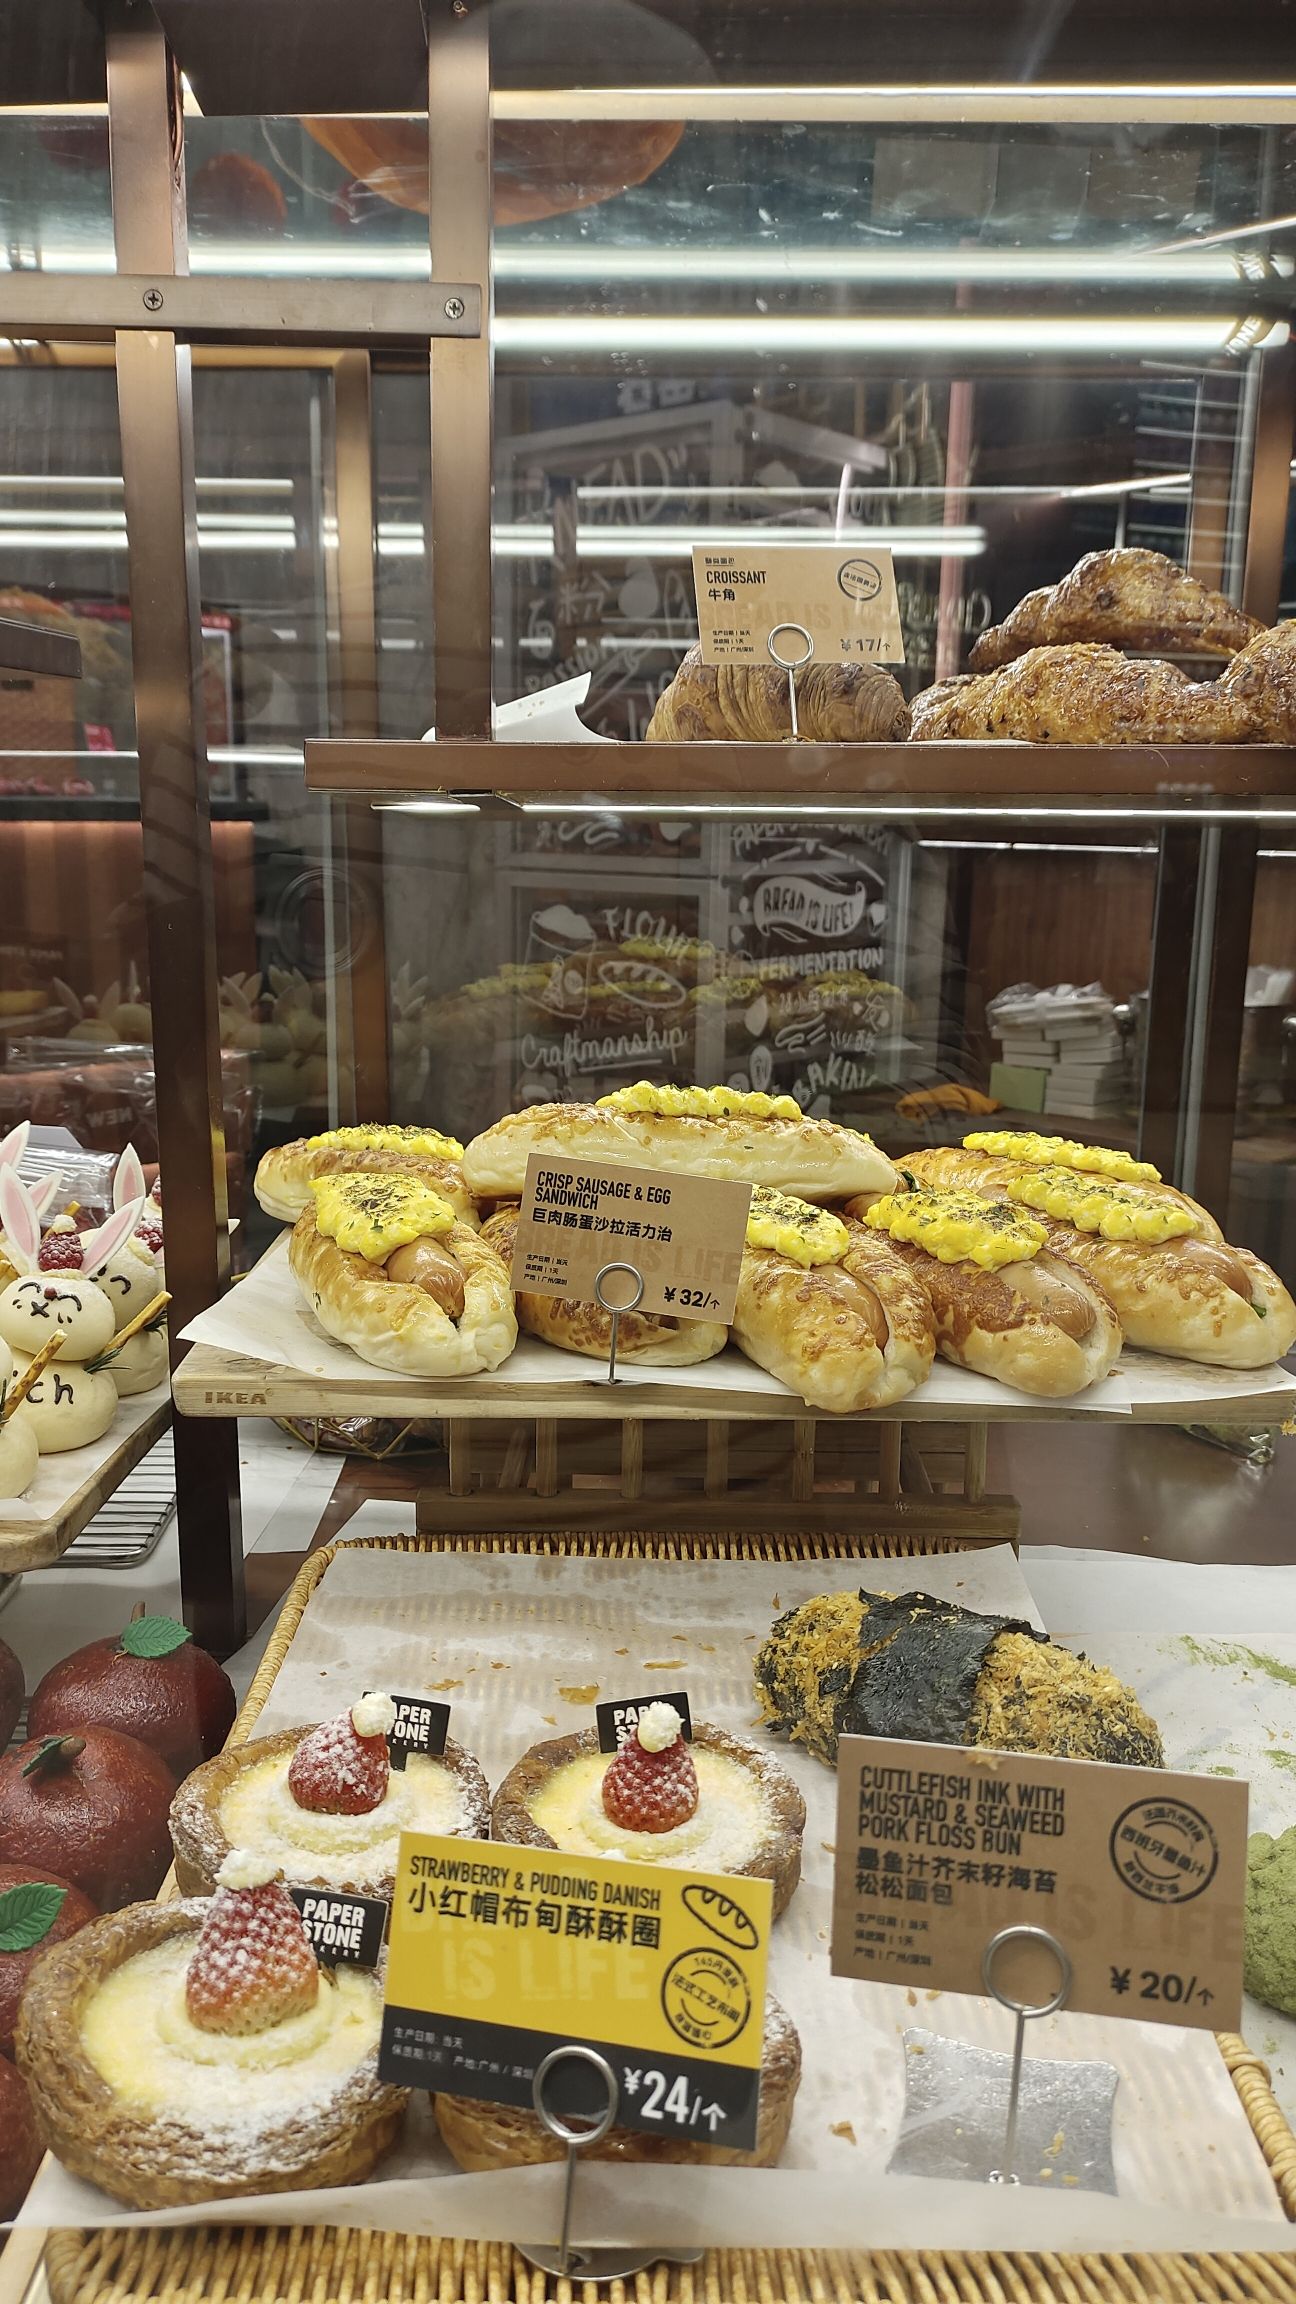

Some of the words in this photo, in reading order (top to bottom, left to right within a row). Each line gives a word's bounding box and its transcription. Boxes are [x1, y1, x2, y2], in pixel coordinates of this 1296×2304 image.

[706, 570, 767, 585] CROISSANT
[708, 588, 736, 602] 牛角
[804, 900, 819, 929] IS
[521, 1016, 688, 1078] Craftmanship
[535, 1187, 598, 1210] SANDWICH
[537, 1170, 573, 1190] CRISP
[575, 1176, 632, 1200] SAUSAGE
[634, 1186, 644, 1201] &
[646, 1186, 672, 1205] EGG
[532, 1207, 673, 1243] 巨肉肠蛋沙拉活力治
[205, 1391, 267, 1405] IKEA
[395, 1704, 432, 1725] PER
[391, 1738, 429, 1750] KERY
[392, 1720, 430, 1742] ONE
[860, 1766, 970, 1800] CUTTLEFISH
[977, 1781, 1011, 1807] INK
[1017, 1785, 1065, 1812] WITH
[858, 1791, 947, 1824] MUSTARD
[955, 1804, 969, 1826] &
[975, 1805, 1065, 1838] SEAWEED
[857, 1815, 909, 1842] PORK
[914, 1822, 976, 1850] FLOSS
[982, 1831, 1022, 1856] BUN
[410, 1855, 509, 1890] STRAWBERRY
[514, 1871, 525, 1891] &
[530, 1871, 597, 1902] PUDDING
[603, 1882, 661, 1911] DANISH
[856, 1846, 1058, 1896] 墨鱼汁芥末籽海苔
[854, 1872, 954, 1906] 松松面包
[302, 1898, 365, 1928] PAPER
[408, 1881, 662, 1950] 小红帽布甸酥酥圈
[301, 1919, 363, 1950] STONE
[319, 1944, 361, 1959] KERY
[442, 1938, 497, 2001] IS
[519, 1937, 651, 2001] LIFE
